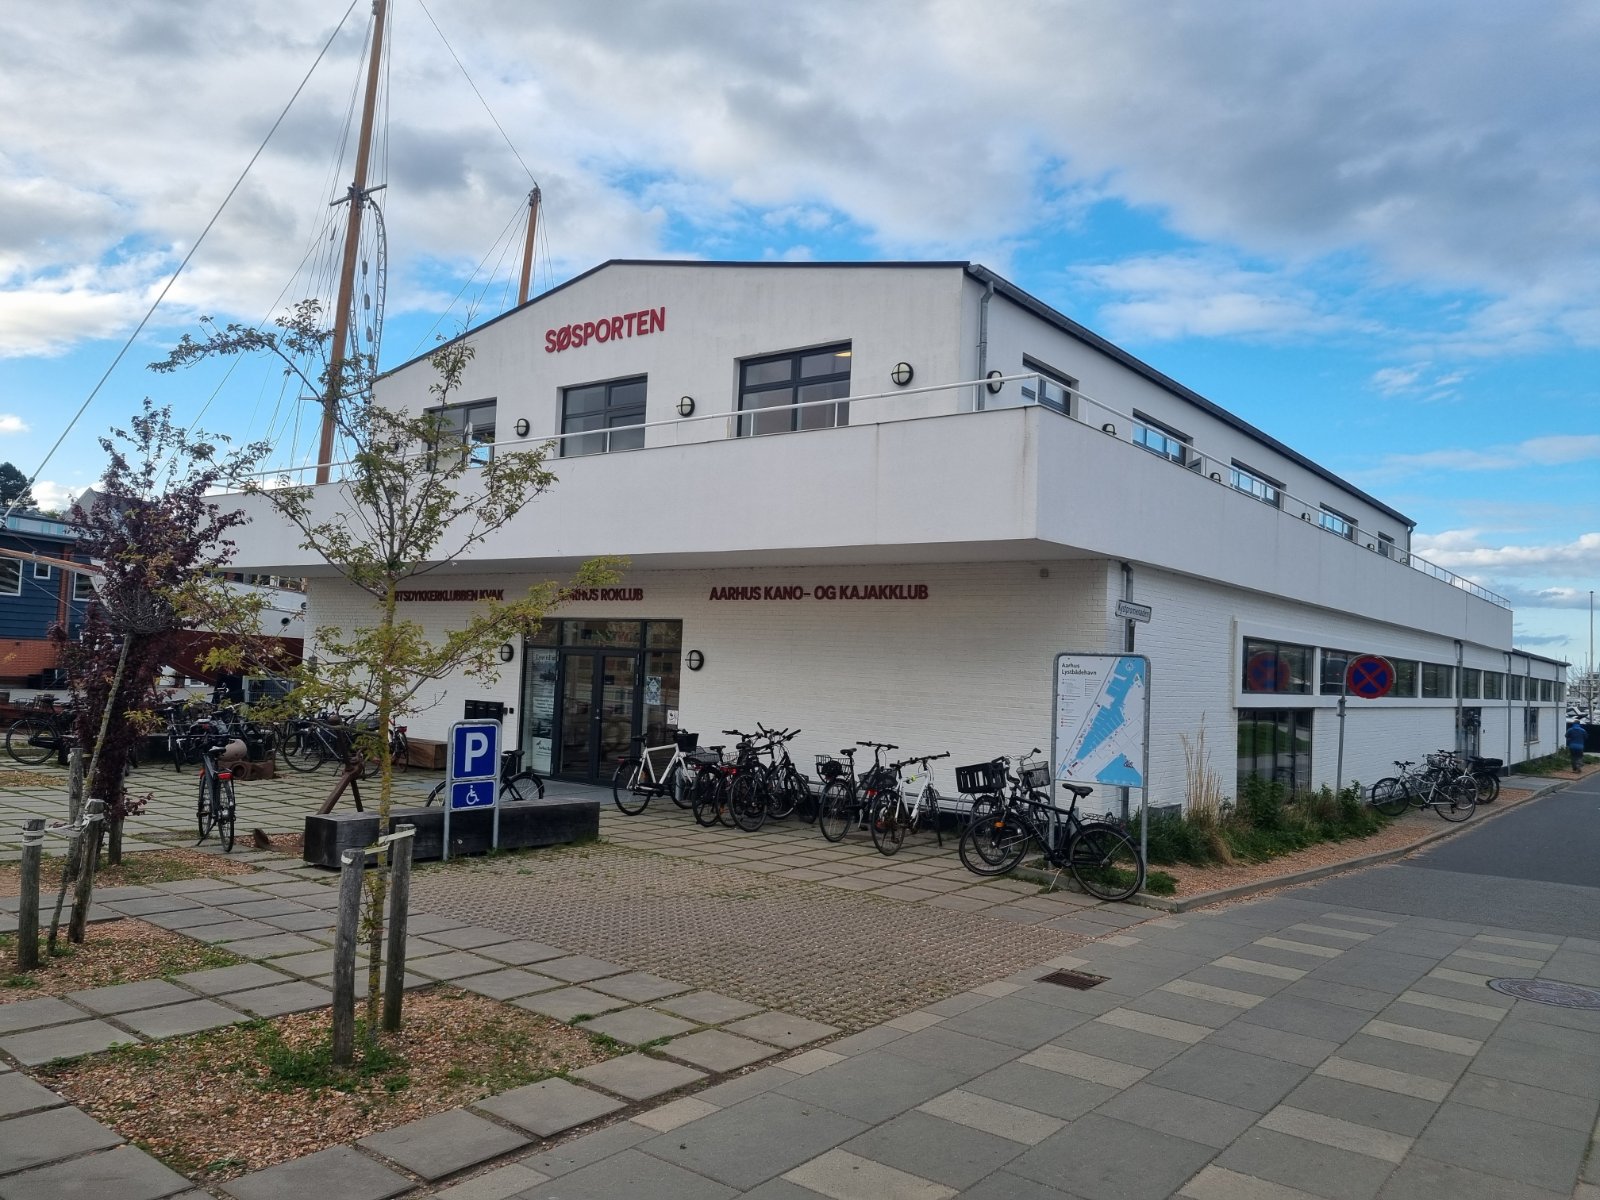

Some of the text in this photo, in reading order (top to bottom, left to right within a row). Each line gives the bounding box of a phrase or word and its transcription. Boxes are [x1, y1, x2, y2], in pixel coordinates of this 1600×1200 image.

[544, 306, 666, 353] SØSPORTEN
[379, 589, 479, 602] RTSDYKKERKLUBBEN
[600, 587, 644, 601] ROKLUB
[709, 584, 929, 601] AARHUS KANO- OG KAJAKKLUB
[464, 732, 489, 773] P
